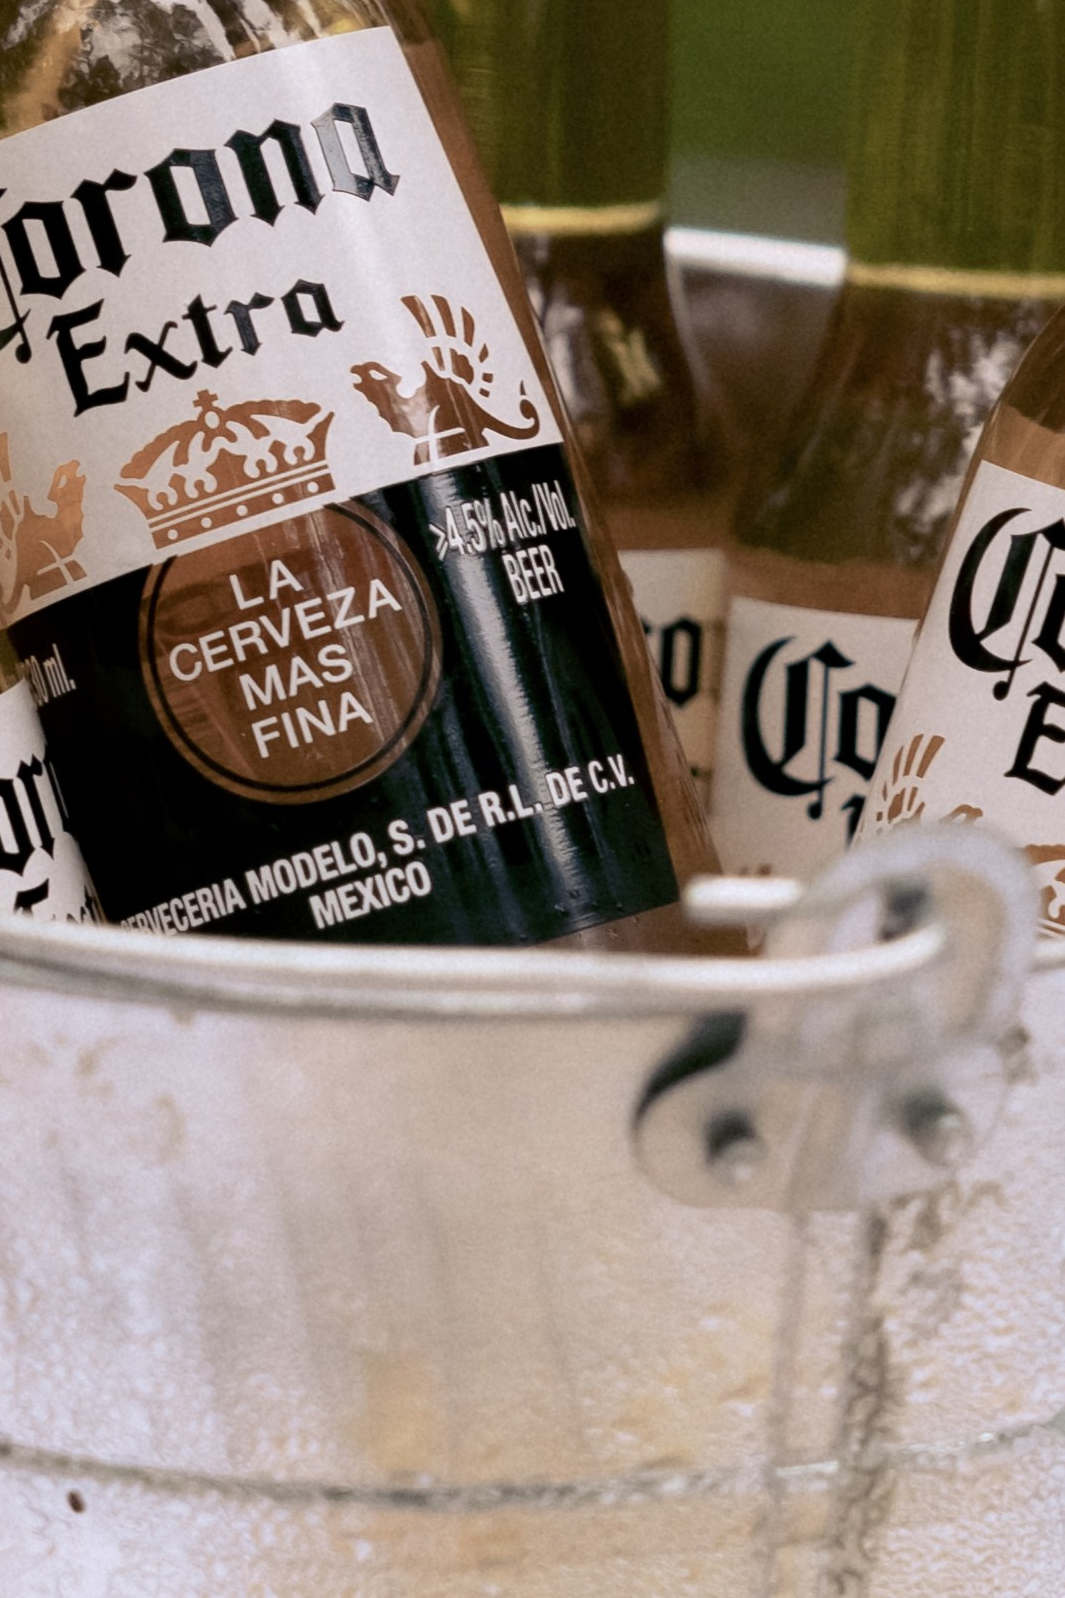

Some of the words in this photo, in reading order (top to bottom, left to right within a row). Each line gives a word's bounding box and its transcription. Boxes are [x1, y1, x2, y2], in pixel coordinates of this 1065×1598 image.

[46, 279, 345, 417] Extra
[500, 479, 576, 542] Alc./Vol.
[229, 559, 305, 610] LA
[501, 544, 565, 606] BEER
[169, 578, 402, 682] CERVEZA
[239, 644, 354, 711] MAS
[251, 691, 374, 759] FINA
[245, 832, 388, 905] MODELO,
[387, 819, 426, 856] S.
[427, 799, 477, 844] DE
[478, 784, 545, 827] R.L.
[546, 765, 589, 807] DE
[587, 754, 635, 795] C.V.
[308, 860, 432, 930] MEXICO
